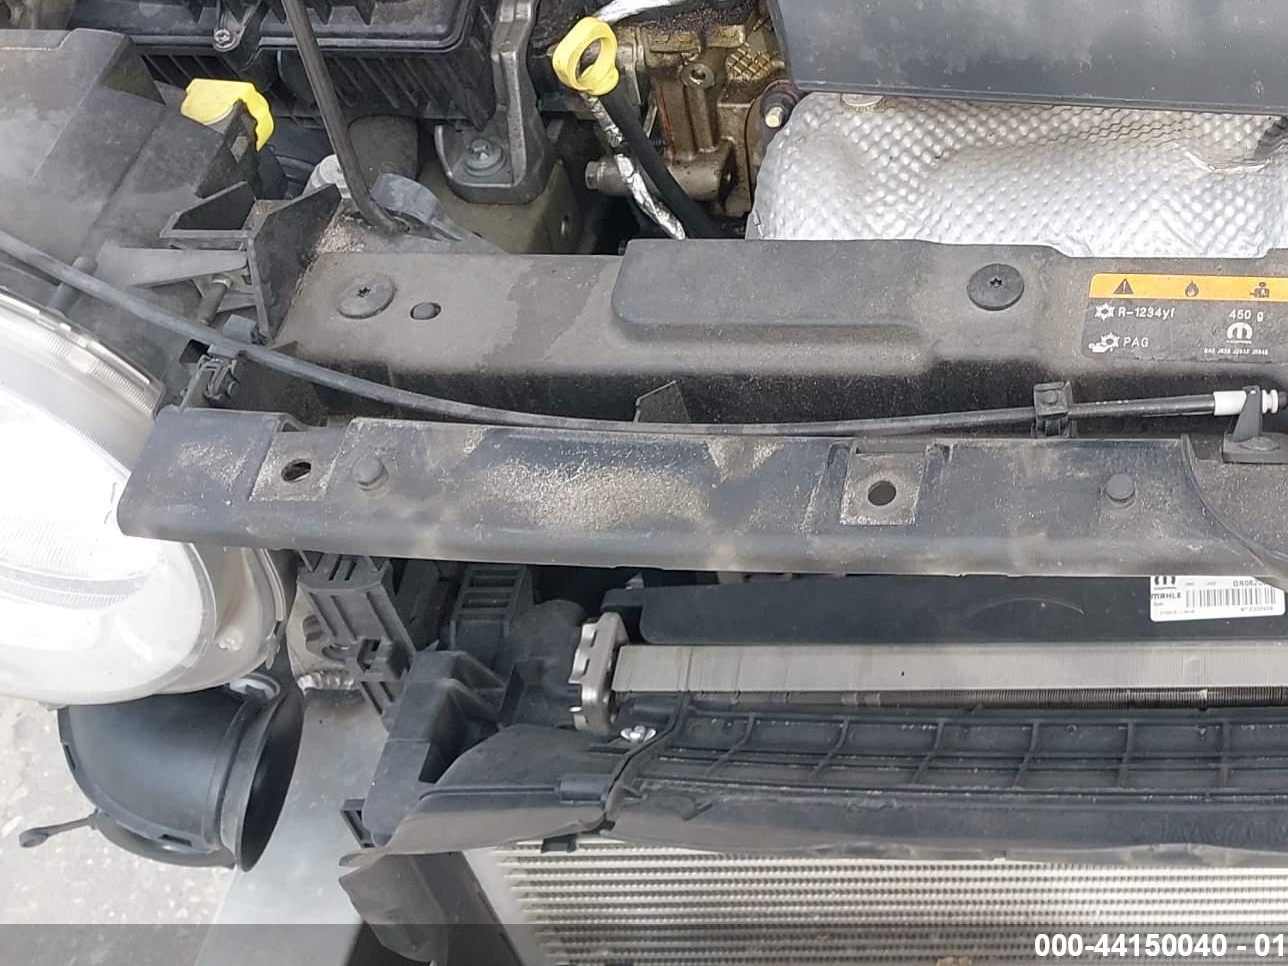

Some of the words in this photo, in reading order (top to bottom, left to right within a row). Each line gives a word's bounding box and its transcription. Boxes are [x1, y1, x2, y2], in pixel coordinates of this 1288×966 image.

[1118, 306, 1175, 321] R-1234yf
[1256, 311, 1264, 323] g
[1123, 337, 1149, 348] PAG
